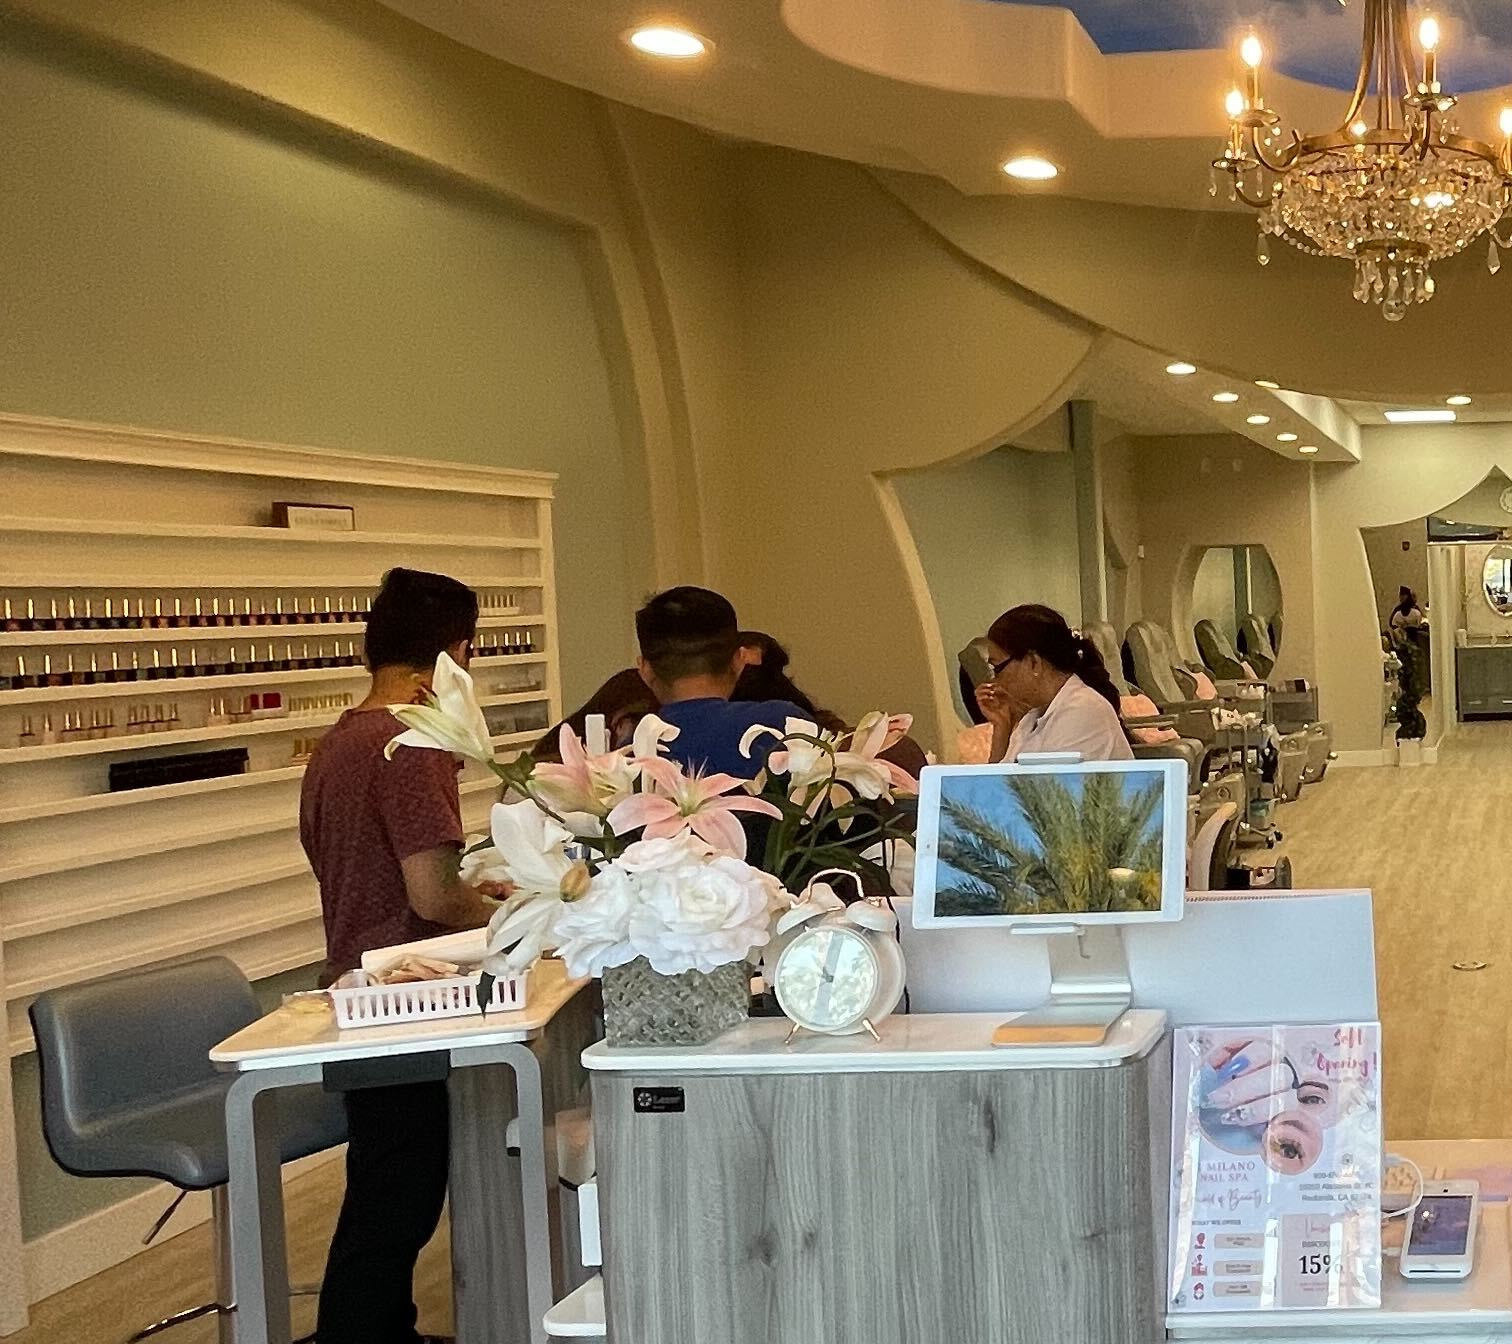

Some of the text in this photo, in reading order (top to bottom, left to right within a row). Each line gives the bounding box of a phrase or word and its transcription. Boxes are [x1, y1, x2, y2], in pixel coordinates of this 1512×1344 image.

[1207, 1160, 1256, 1172] MILANO
[1228, 1172, 1249, 1183] SPA
[1298, 1254, 1344, 1275] 15%
